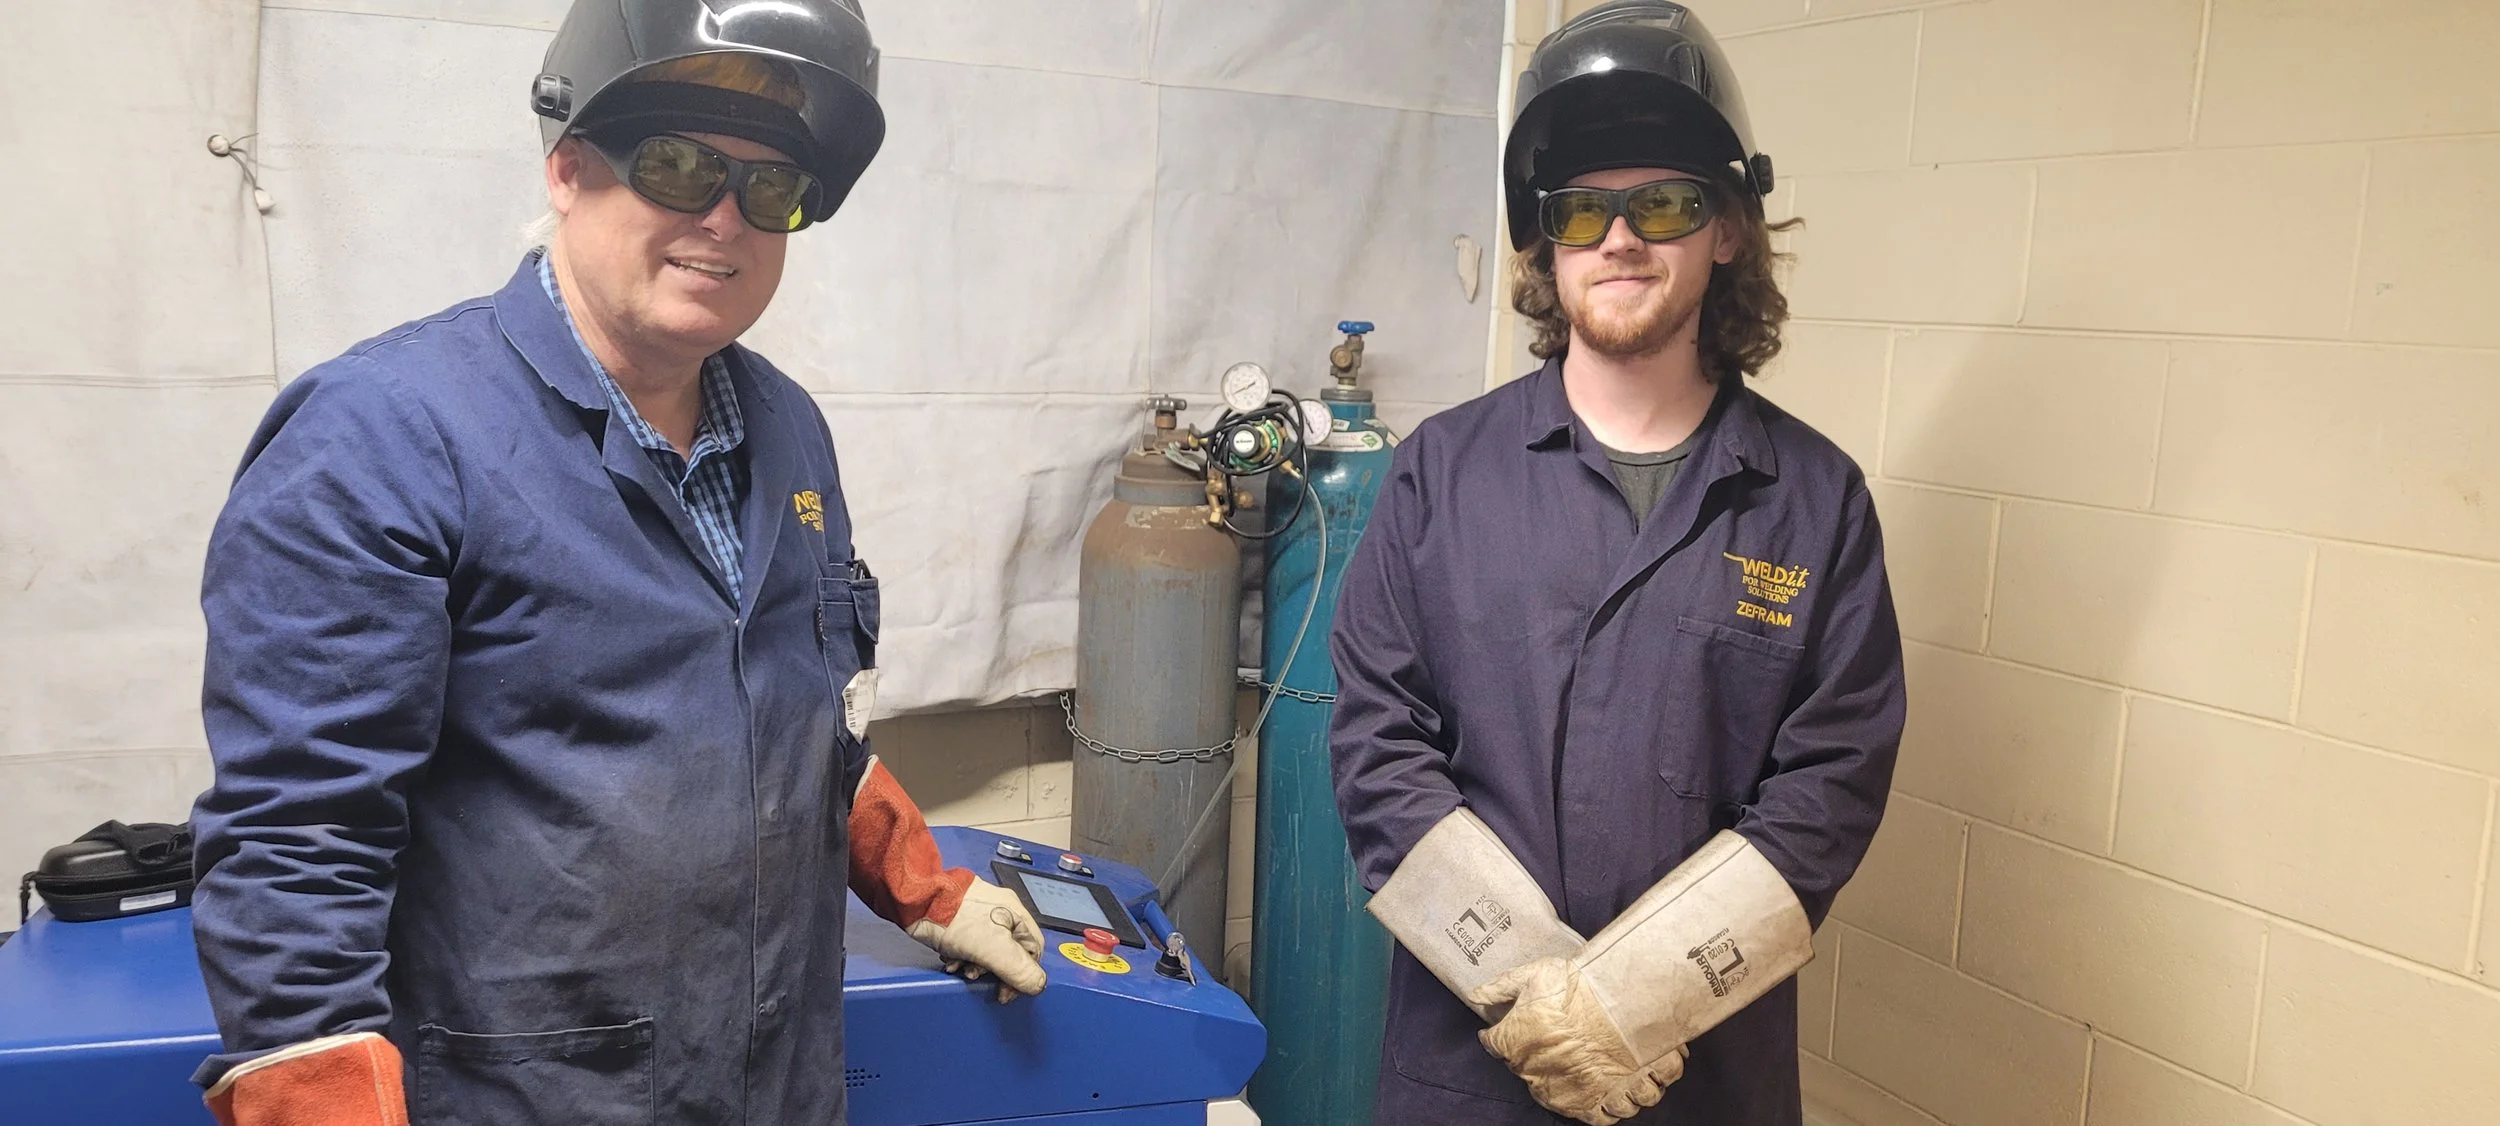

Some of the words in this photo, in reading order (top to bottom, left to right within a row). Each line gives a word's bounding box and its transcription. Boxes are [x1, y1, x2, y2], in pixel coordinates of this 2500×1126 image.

[1742, 575, 1760, 588] FOR
[1760, 580, 1799, 597] WELDING
[1747, 585, 1790, 604] SOLUTIONS
[1736, 600, 1793, 628] ZEFRAM
[1695, 953, 1724, 998] ARMOUR
